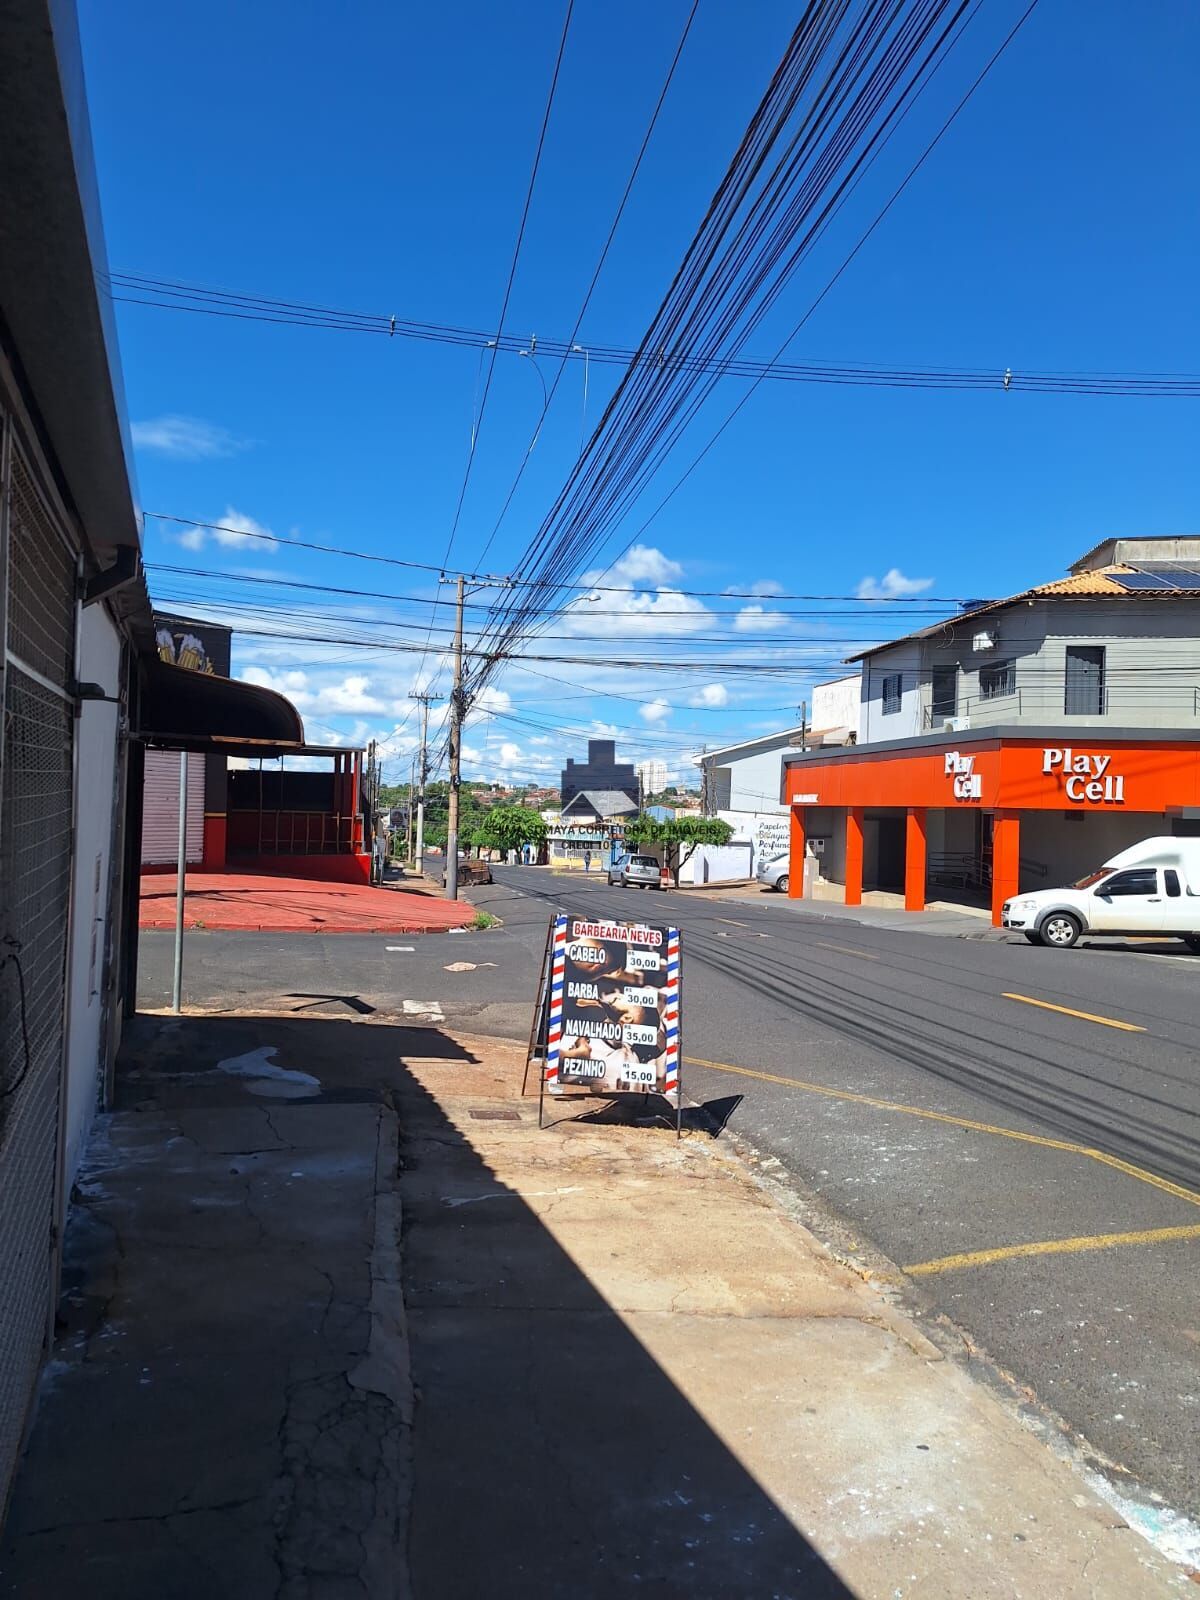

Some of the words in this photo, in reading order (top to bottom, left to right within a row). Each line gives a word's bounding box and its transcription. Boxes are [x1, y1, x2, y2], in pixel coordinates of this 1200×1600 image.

[944, 751, 976, 778] Play
[1042, 748, 1111, 780] Play
[954, 774, 983, 798] Cell
[1066, 775, 1125, 801] Cell
[574, 922, 628, 941] BARBEARIA
[630, 929, 661, 945] NEVES
[569, 945, 606, 964] CABELO
[630, 957, 656, 968] 30,00
[567, 981, 599, 1000] BARBA
[627, 994, 654, 1005] 30,00
[565, 1019, 621, 1040] NAVALHADO
[626, 1031, 653, 1043] 35,00
[563, 1057, 605, 1078] PEZINHO
[625, 1070, 652, 1082] 15,00
